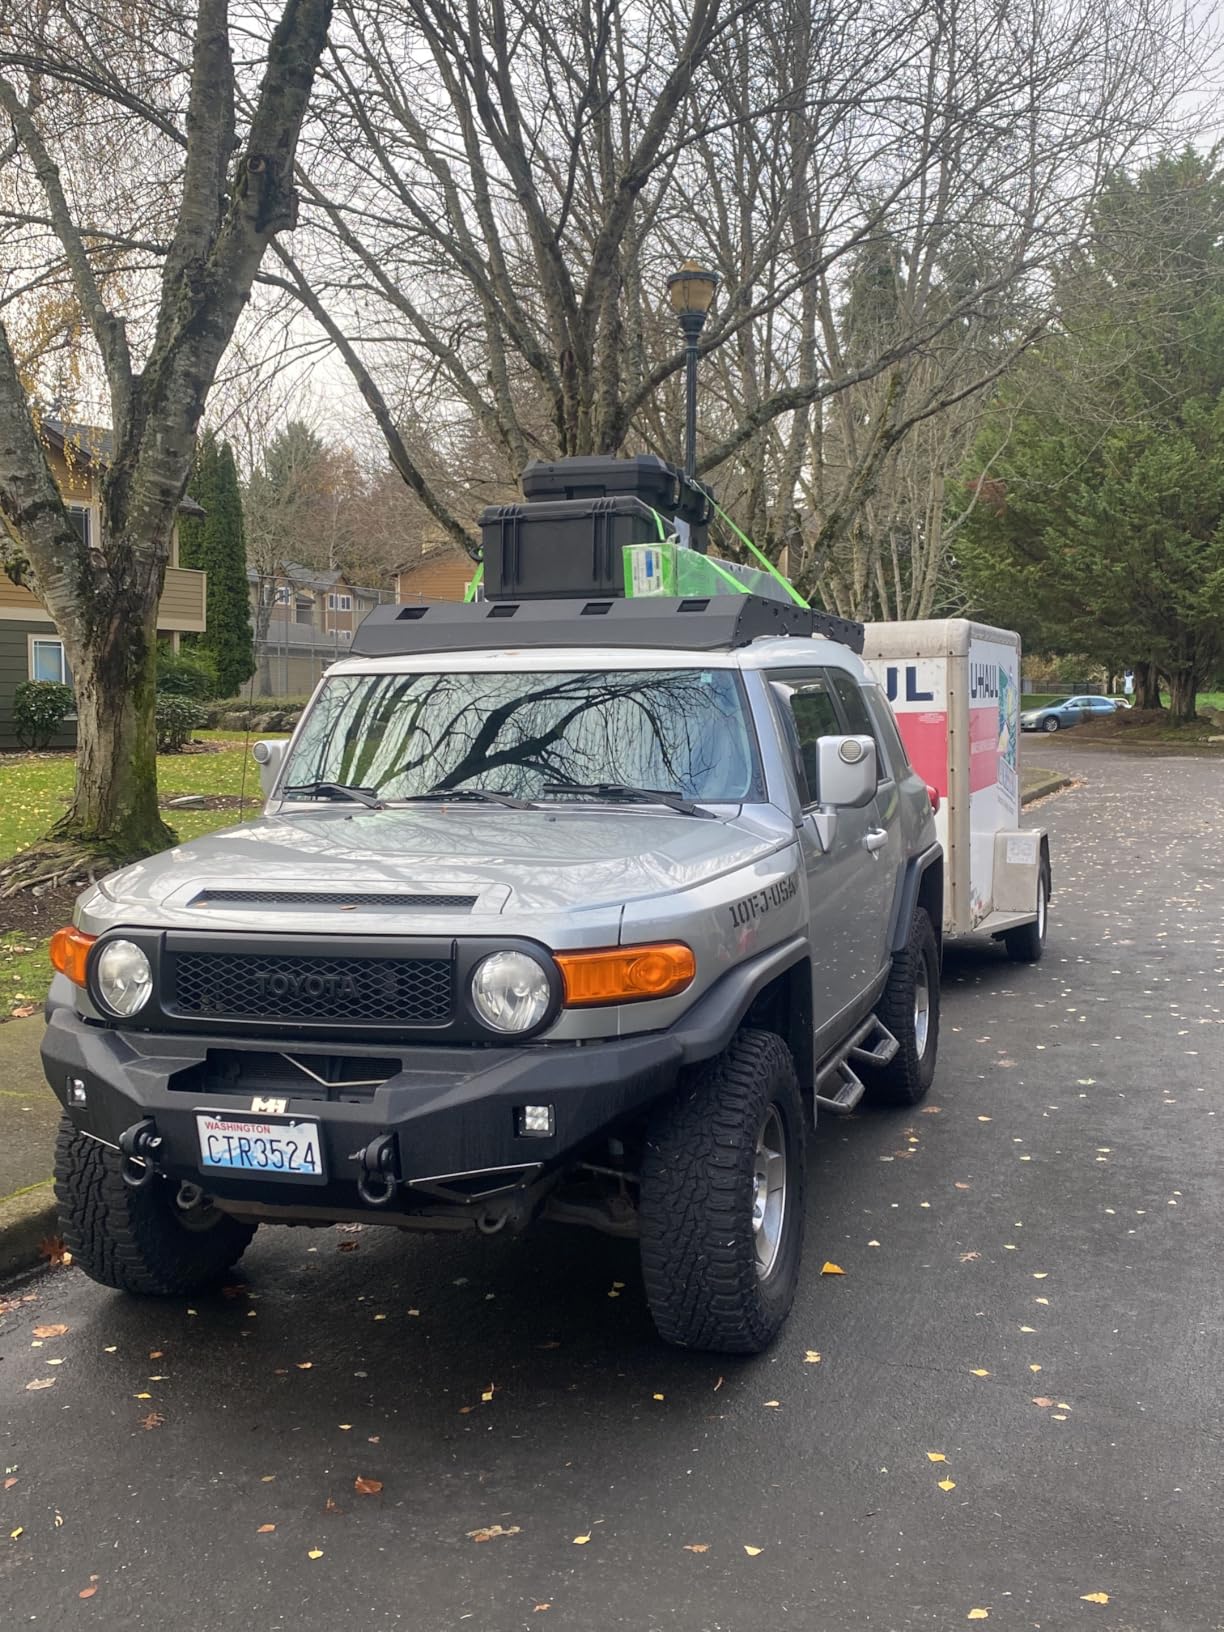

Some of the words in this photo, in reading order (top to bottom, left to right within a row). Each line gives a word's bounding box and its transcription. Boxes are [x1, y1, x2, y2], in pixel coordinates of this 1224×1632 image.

[970, 663, 998, 699] U-HAUL
[255, 973, 360, 998] TOYOTA
[204, 1121, 271, 1134] WASHINGTON
[207, 1134, 316, 1172] CTR3524
